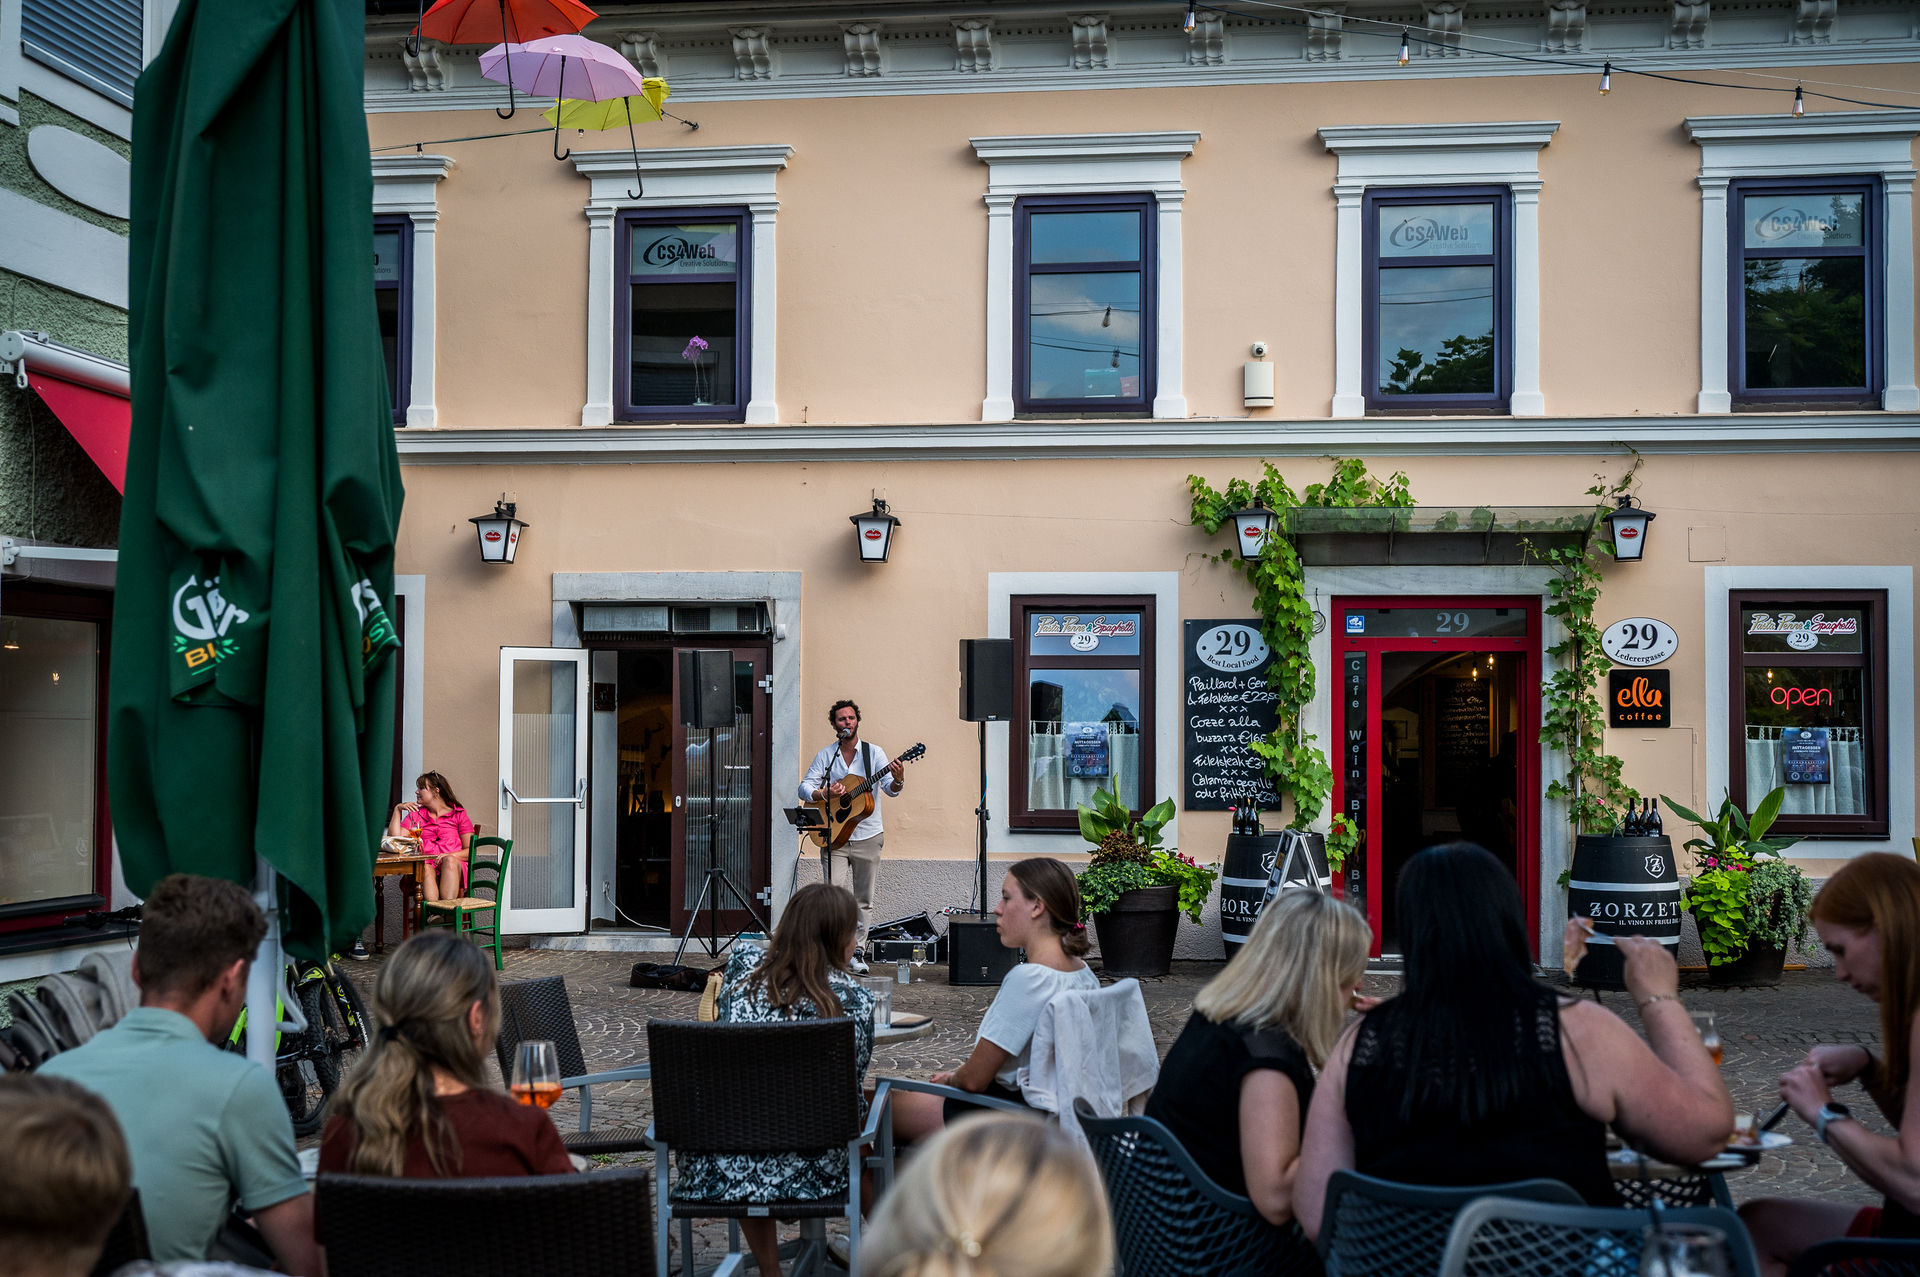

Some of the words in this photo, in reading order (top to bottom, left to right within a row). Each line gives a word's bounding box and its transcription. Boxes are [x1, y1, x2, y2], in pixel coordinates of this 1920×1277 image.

[1405, 225, 1469, 241] CS4Web
[657, 243, 716, 260] CS4Web
[1039, 616, 1061, 633] Pasta
[1062, 616, 1085, 633] Penne
[1086, 622, 1093, 632] &
[1092, 616, 1135, 637] Spaghetti
[1436, 612, 1470, 633] 29
[1751, 613, 1776, 632] Pasta
[1777, 613, 1803, 631] Penne
[1803, 620, 1811, 631] &
[1811, 613, 1857, 635] Spaghetti
[1078, 634, 1091, 644] 29
[1215, 630, 1251, 657] 29
[1621, 623, 1658, 650] 29
[1795, 633, 1810, 643] 29
[1206, 654, 1221, 667] Best
[1222, 660, 1241, 669] Local
[1242, 654, 1260, 668] Food
[1614, 650, 1666, 664] Lederergasse
[1351, 660, 1360, 708] Cafe
[1617, 676, 1663, 708] ella
[1770, 686, 1832, 711] open
[1190, 716, 1225, 729] Cozze
[1228, 715, 1261, 728] alla
[1619, 712, 1662, 720] coffee
[1195, 731, 1236, 743] buzzara
[1349, 730, 1361, 778] Wein
[1589, 901, 1680, 918] ZORZET
[1654, 918, 1672, 926] FRIULI
